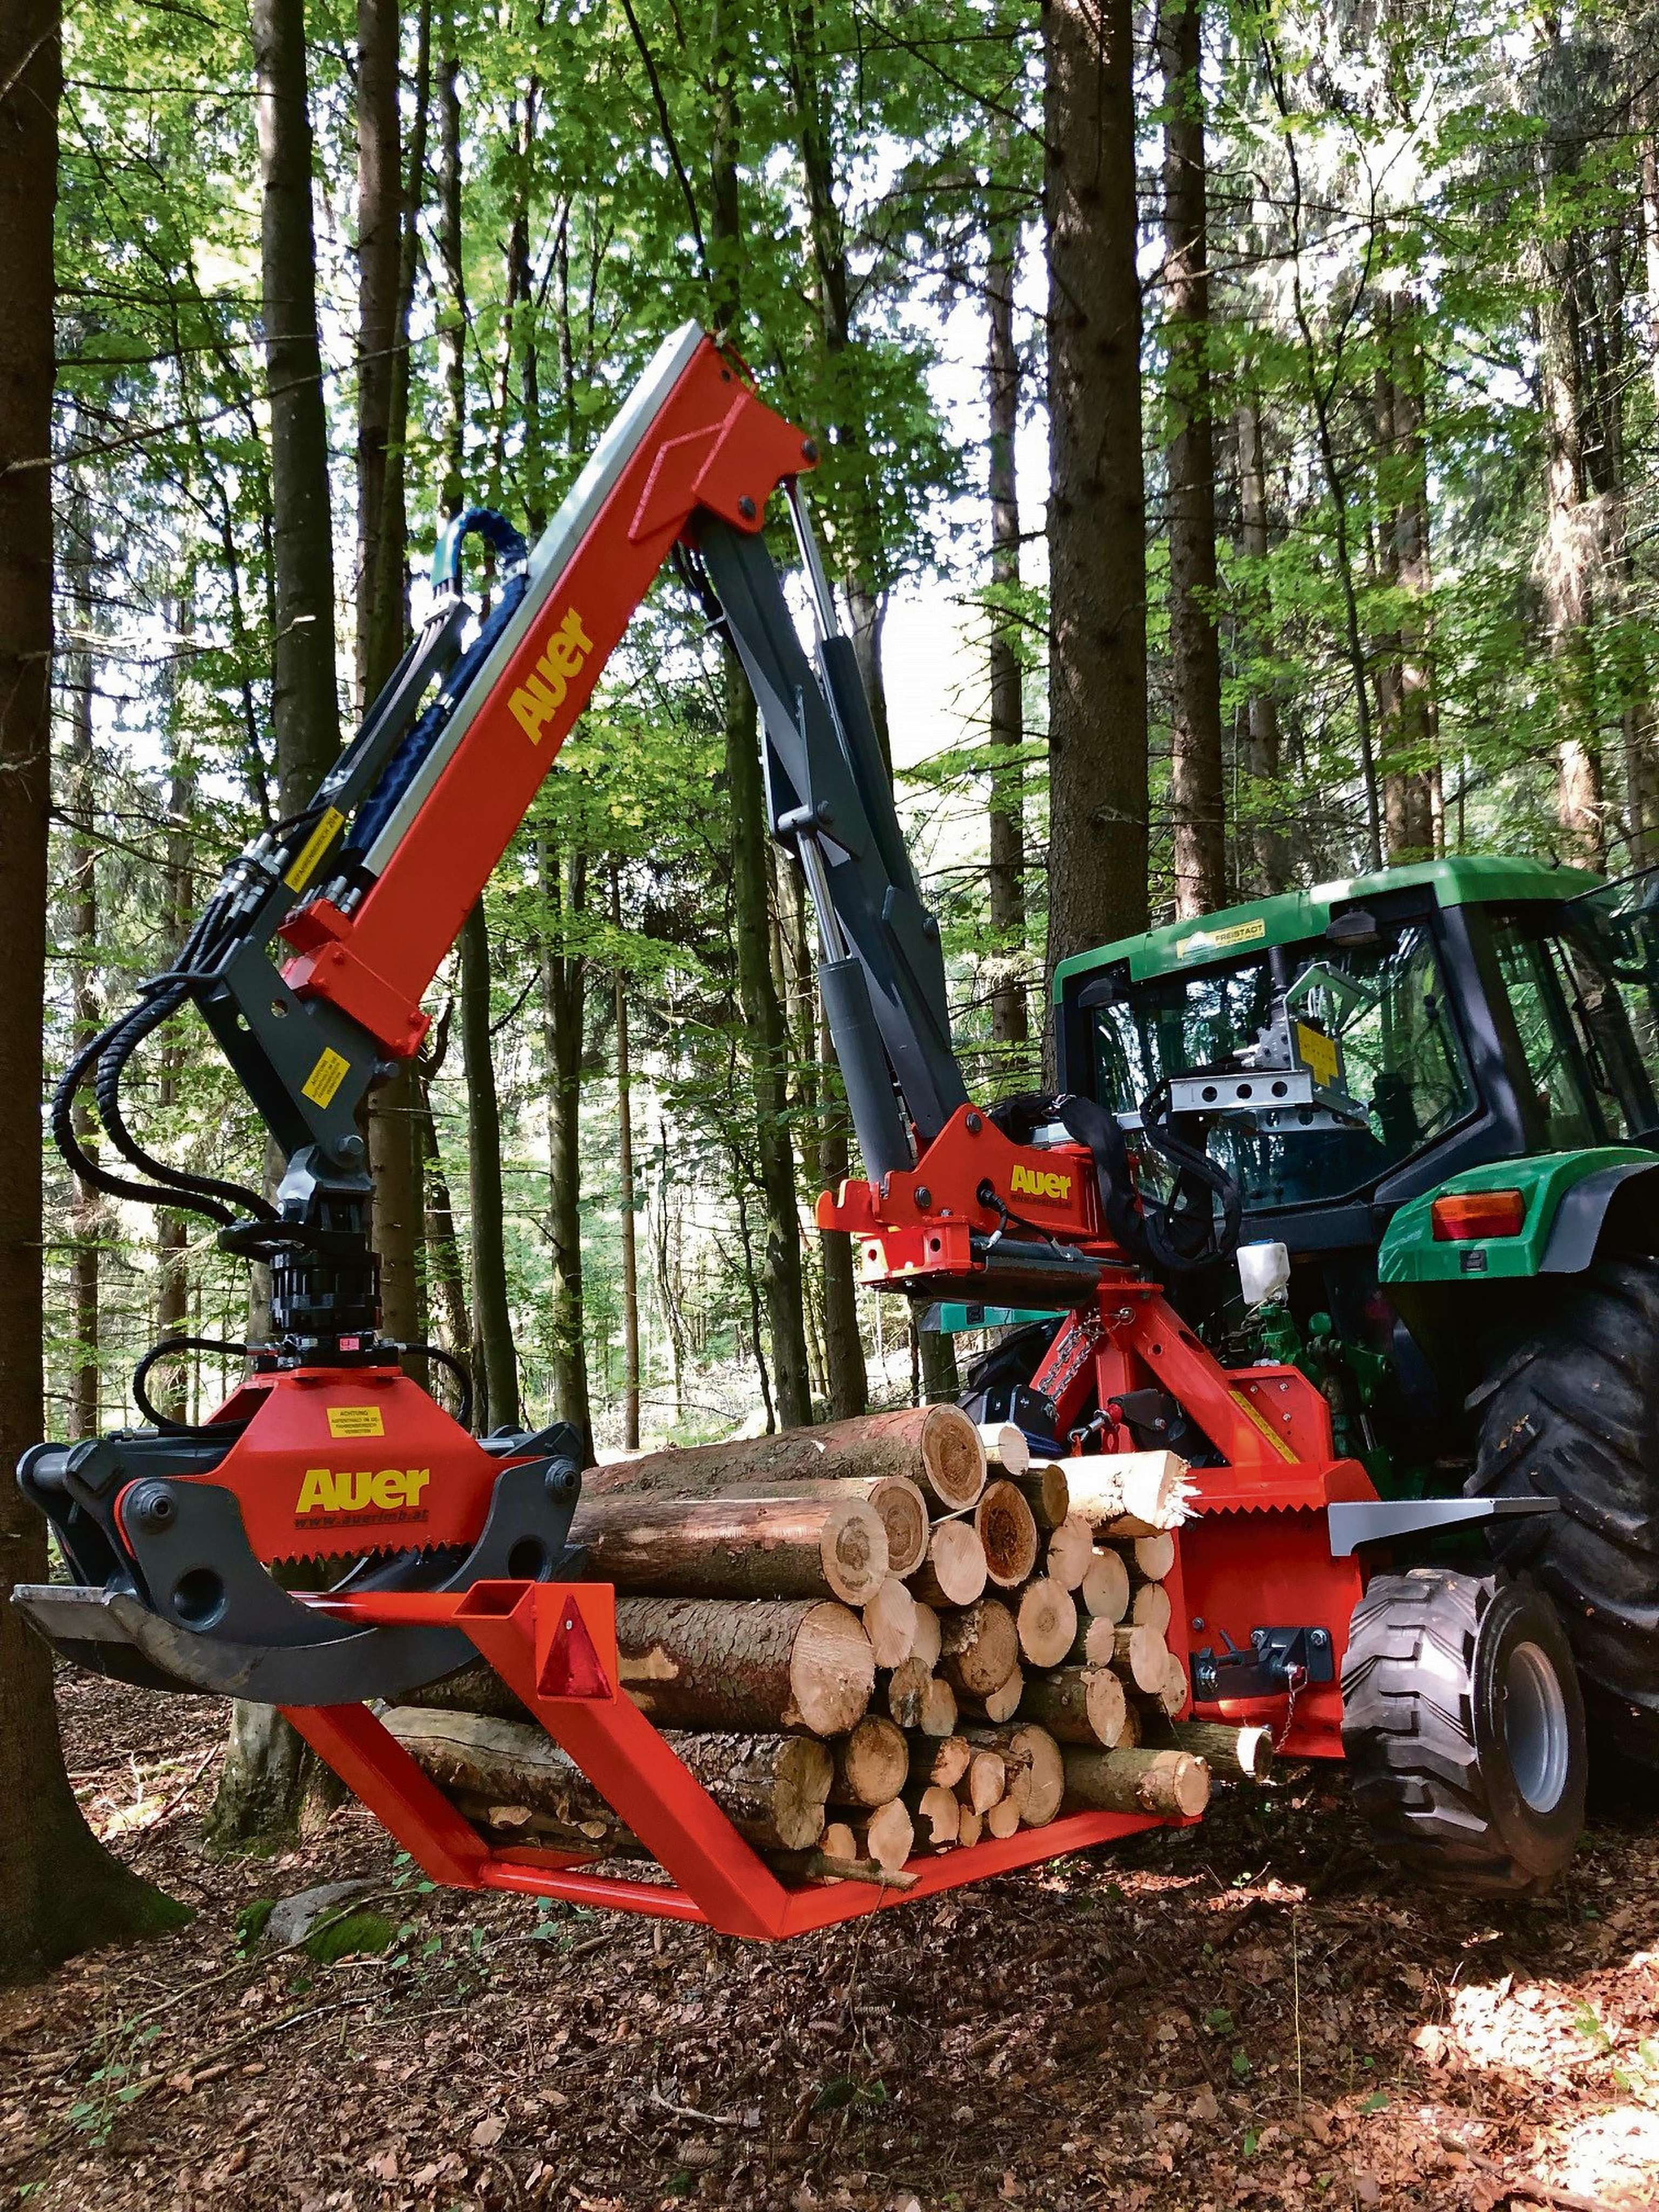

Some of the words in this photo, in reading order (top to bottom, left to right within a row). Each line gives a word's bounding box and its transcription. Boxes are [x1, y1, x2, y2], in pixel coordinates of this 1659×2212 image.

[507, 608, 594, 746] Auer
[1010, 1164, 1072, 1200] Auer
[295, 1468, 430, 1513] Auer
